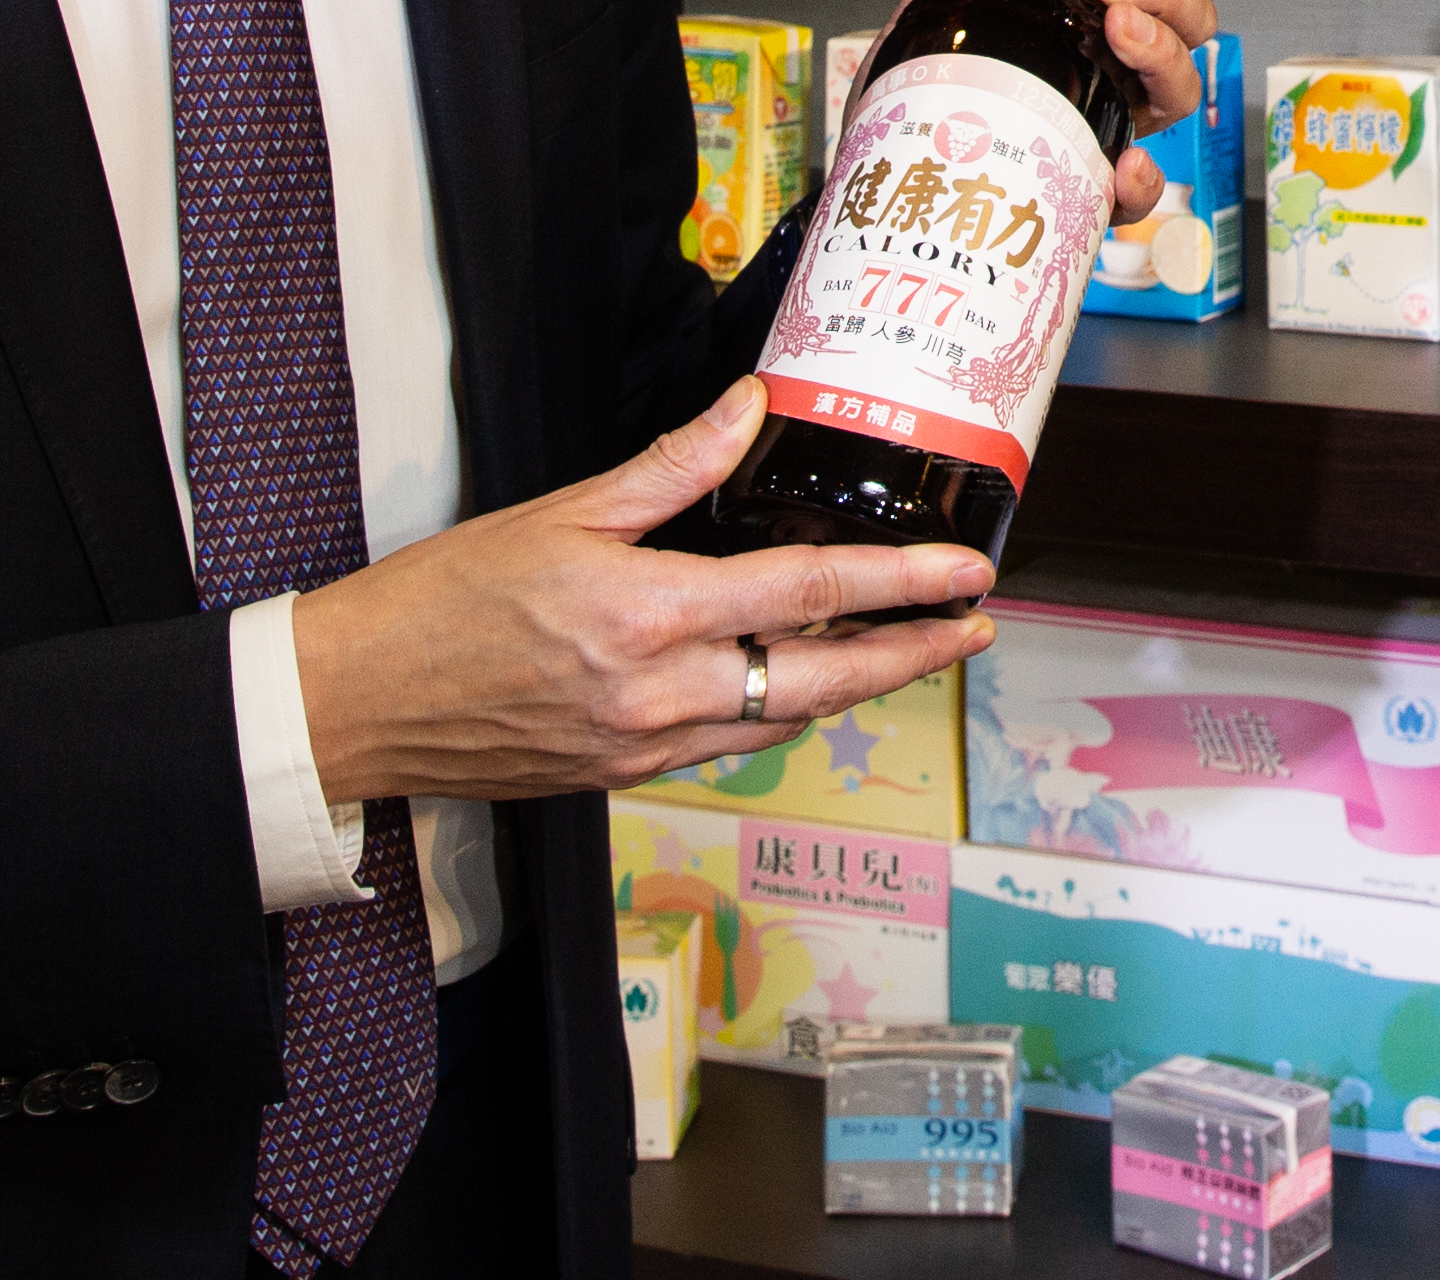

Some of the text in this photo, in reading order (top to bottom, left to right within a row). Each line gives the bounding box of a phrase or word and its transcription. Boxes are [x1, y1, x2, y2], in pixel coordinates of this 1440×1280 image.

[900, 121, 1028, 165] 滋養 強壯
[833, 156, 1046, 270] 健康有力
[823, 233, 1008, 288] CALORY
[823, 266, 997, 335] BAR 777 BAR
[825, 313, 967, 366] 當歸 人參 川芎
[812, 391, 918, 437] 漢方補品
[754, 836, 903, 893] 康貝兒
[923, 1116, 1000, 1149] 995
